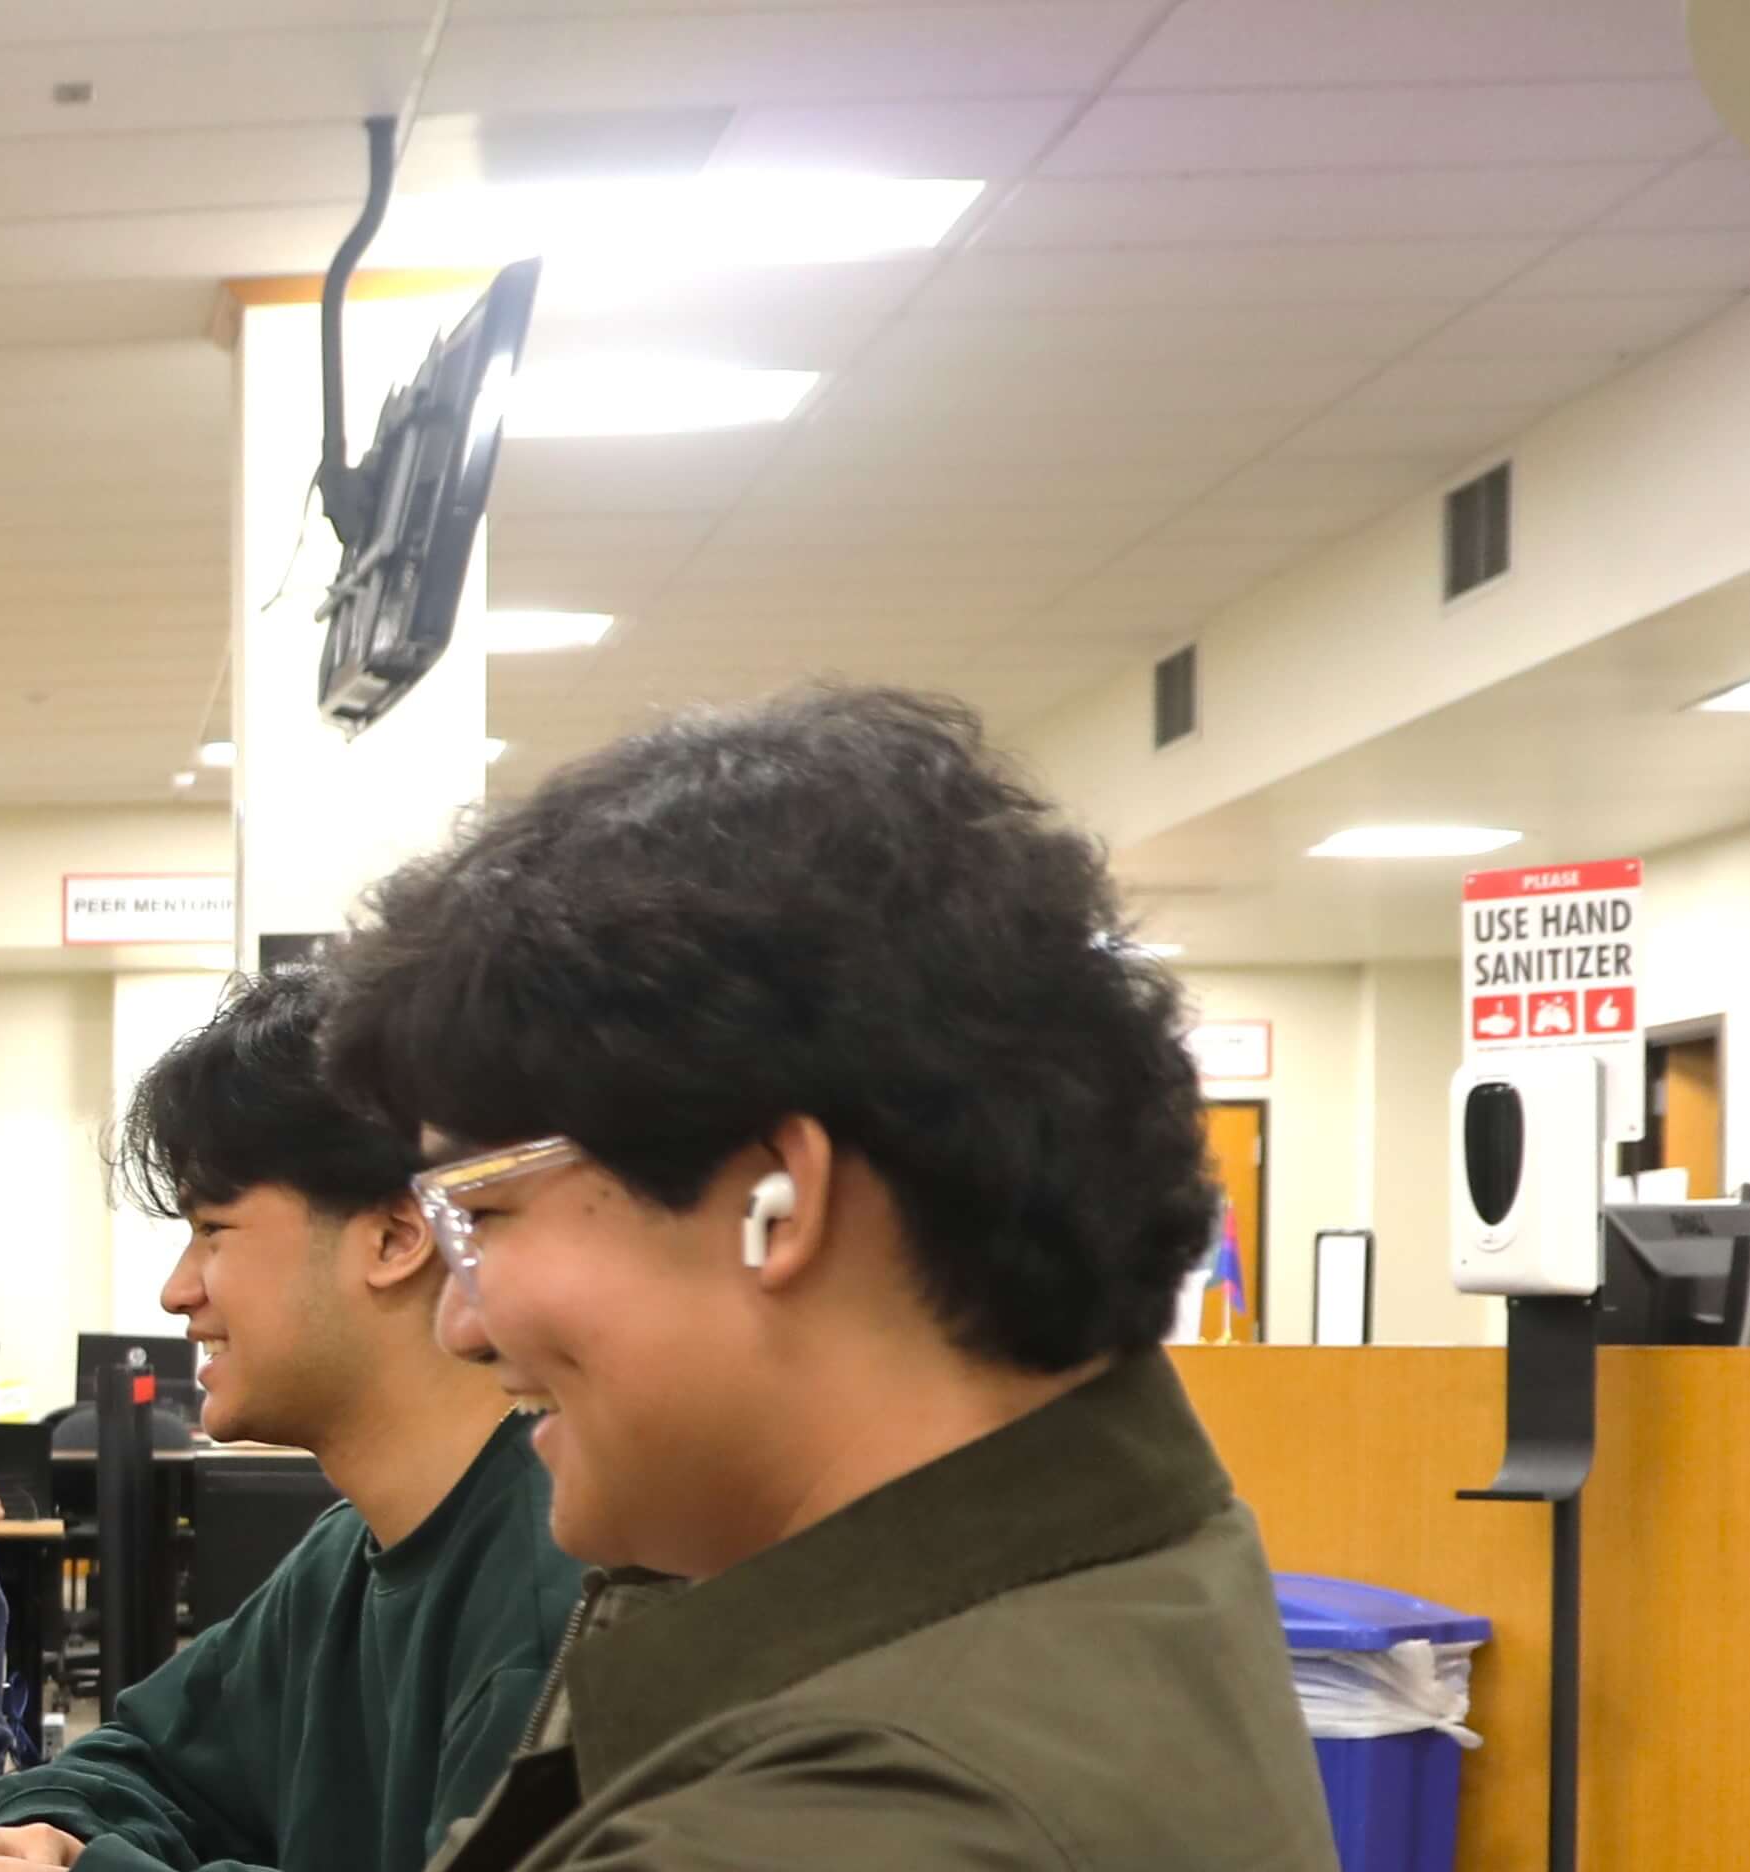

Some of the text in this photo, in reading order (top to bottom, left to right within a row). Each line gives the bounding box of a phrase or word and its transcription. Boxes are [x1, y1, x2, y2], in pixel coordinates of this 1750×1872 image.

[1521, 869, 1580, 890] PLEASE
[73, 897, 126, 913] PEER
[1474, 899, 1633, 942] USE HAND
[1475, 943, 1633, 986] SANITIZER
